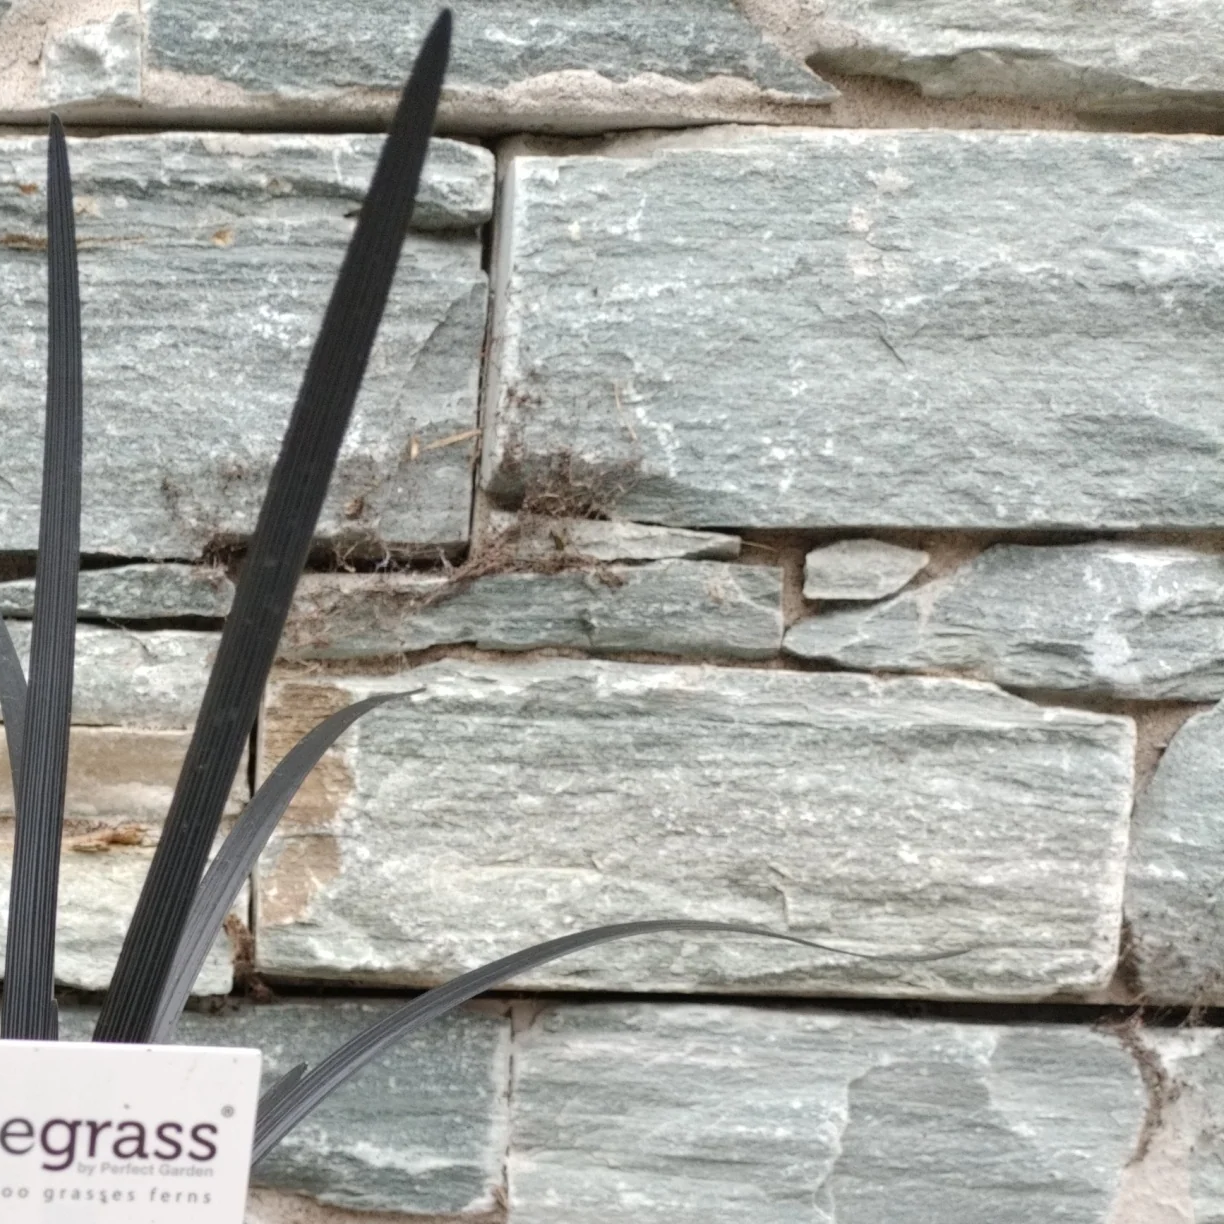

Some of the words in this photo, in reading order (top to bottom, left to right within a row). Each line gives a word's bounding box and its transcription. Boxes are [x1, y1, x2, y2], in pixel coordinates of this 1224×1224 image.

[77, 1161, 96, 1176] by
[101, 1162, 155, 1176] Perfect
[159, 1164, 214, 1177] Garden
[43, 1186, 136, 1204] grasses
[150, 1187, 212, 1205] ferns
